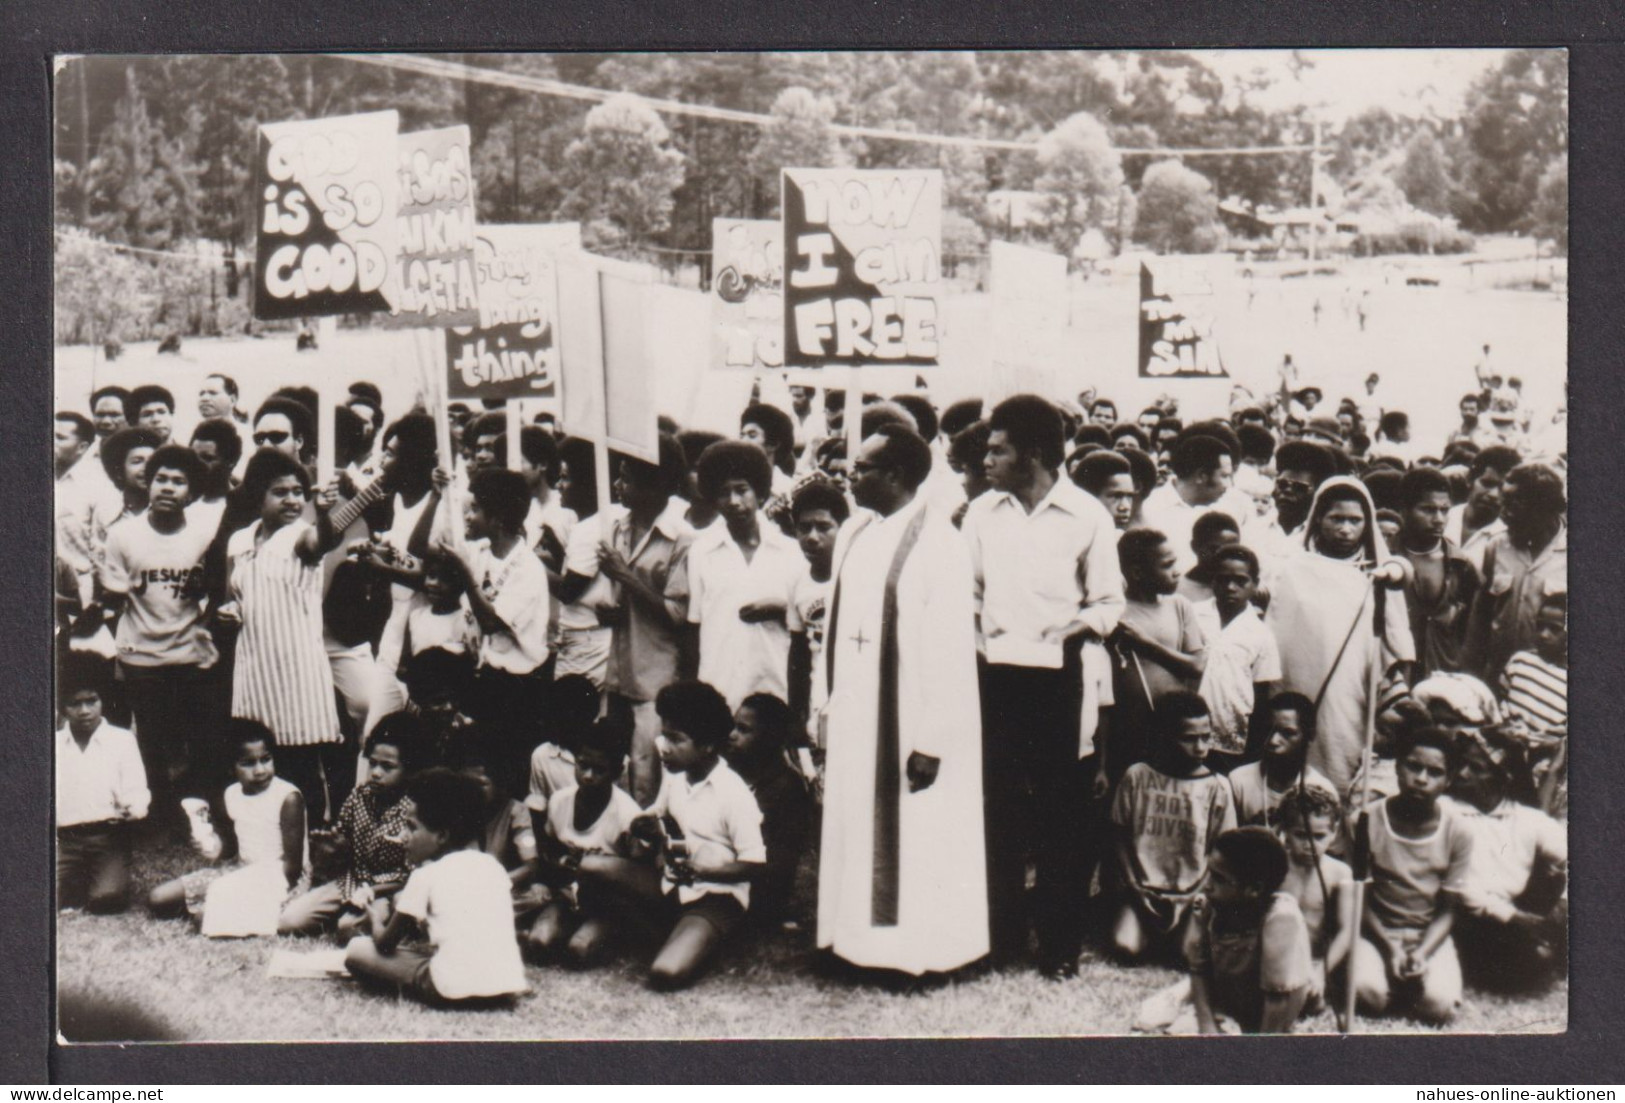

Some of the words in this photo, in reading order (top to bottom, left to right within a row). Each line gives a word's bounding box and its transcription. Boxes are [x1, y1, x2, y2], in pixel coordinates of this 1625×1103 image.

[323, 181, 384, 232] SO
[265, 240, 388, 299] GOOD
[790, 232, 840, 288] I
[854, 237, 940, 286] am
[795, 296, 940, 359] FREE
[454, 338, 556, 388] thing
